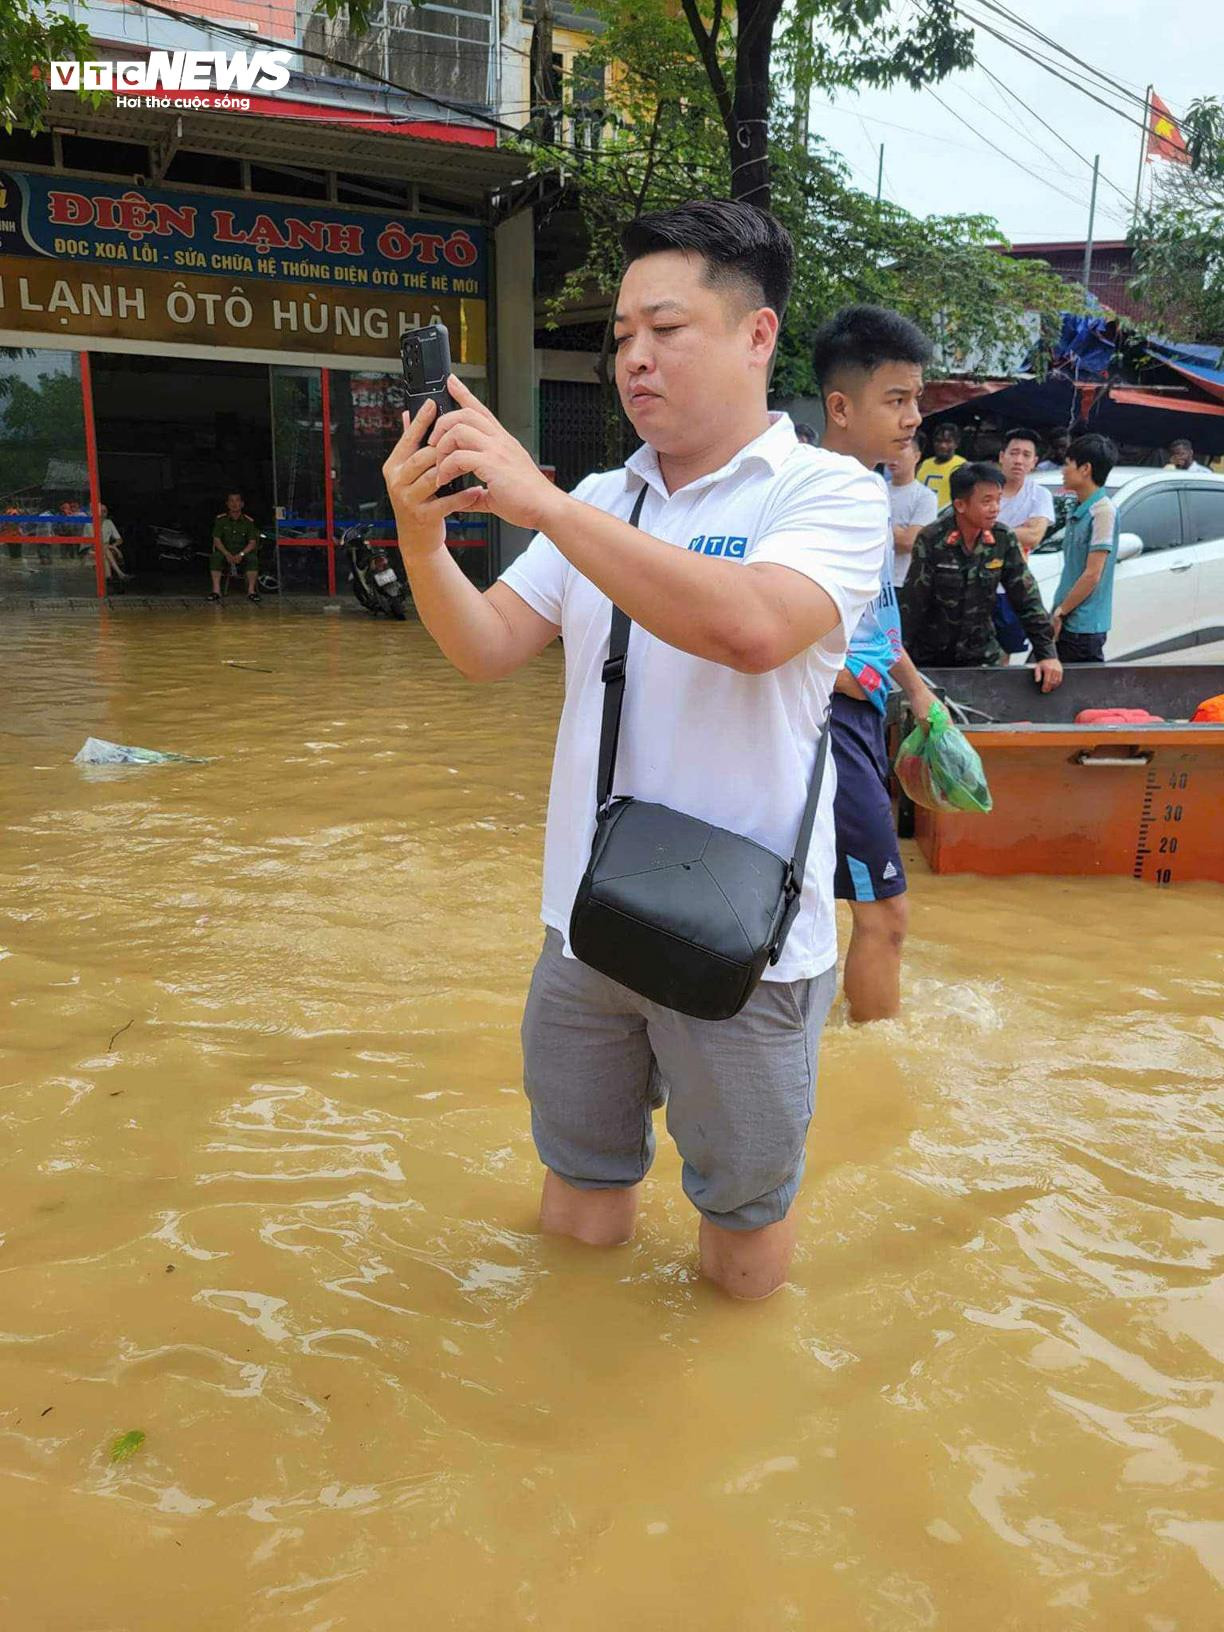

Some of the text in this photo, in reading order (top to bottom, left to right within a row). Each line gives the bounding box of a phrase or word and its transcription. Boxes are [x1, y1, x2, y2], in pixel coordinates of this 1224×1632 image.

[48, 191, 197, 240] ĐIỆN
[211, 210, 364, 254] LẠNH
[377, 222, 478, 267] ÔTÔ
[54, 238, 89, 257] ĐỌC
[95, 242, 128, 259] XOÁ
[133, 243, 158, 262] LỖI
[174, 247, 207, 267] SỬA
[211, 254, 253, 271] CHỮA
[257, 257, 277, 278] HỆ
[281, 259, 330, 279] THỐNG
[335, 265, 368, 285] ĐIỆN
[402, 271, 427, 289] THẾ
[431, 275, 448, 292] HỆ
[453, 276, 478, 294] MỚI
[19, 278, 146, 325] LẠNH
[166, 281, 253, 328] ÔTÔ
[272, 293, 389, 339] HÙNG
[1164, 804, 1183, 821] 30
[1158, 836, 1178, 853] 20
[1155, 868, 1171, 884] 10
